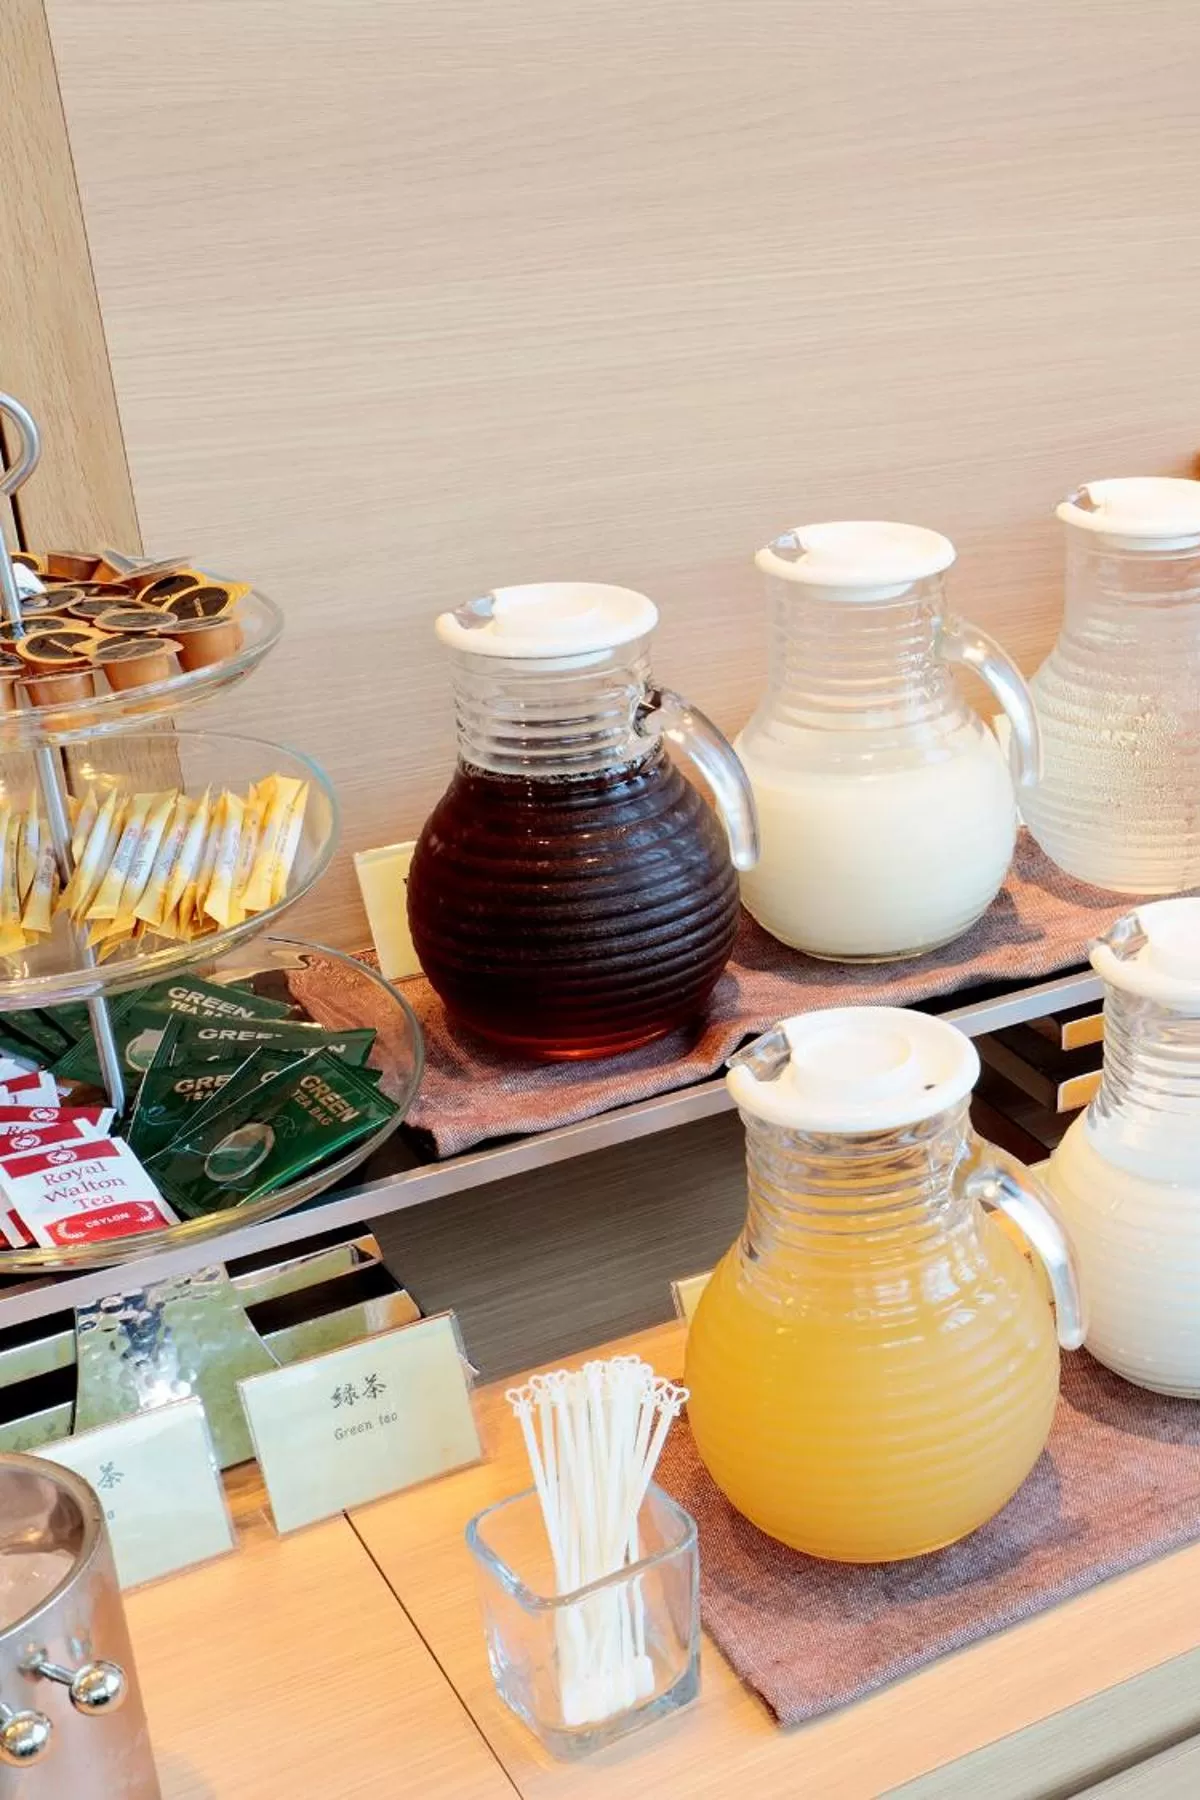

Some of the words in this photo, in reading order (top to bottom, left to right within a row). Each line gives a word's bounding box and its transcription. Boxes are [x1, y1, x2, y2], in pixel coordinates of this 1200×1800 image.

[167, 986, 256, 1019] GREEN
[170, 1000, 198, 1015] TEA
[198, 1028, 284, 1041] GREE
[173, 1074, 232, 1094] GRE
[291, 1089, 313, 1109] TEA
[309, 1107, 334, 1126] BAG
[300, 1075, 361, 1123] GREEN
[41, 1160, 108, 1186] Royal
[43, 1177, 128, 1203] Walton
[72, 1194, 115, 1210] Tea
[84, 1212, 131, 1229] CEYLON
[333, 1420, 373, 1441] Green
